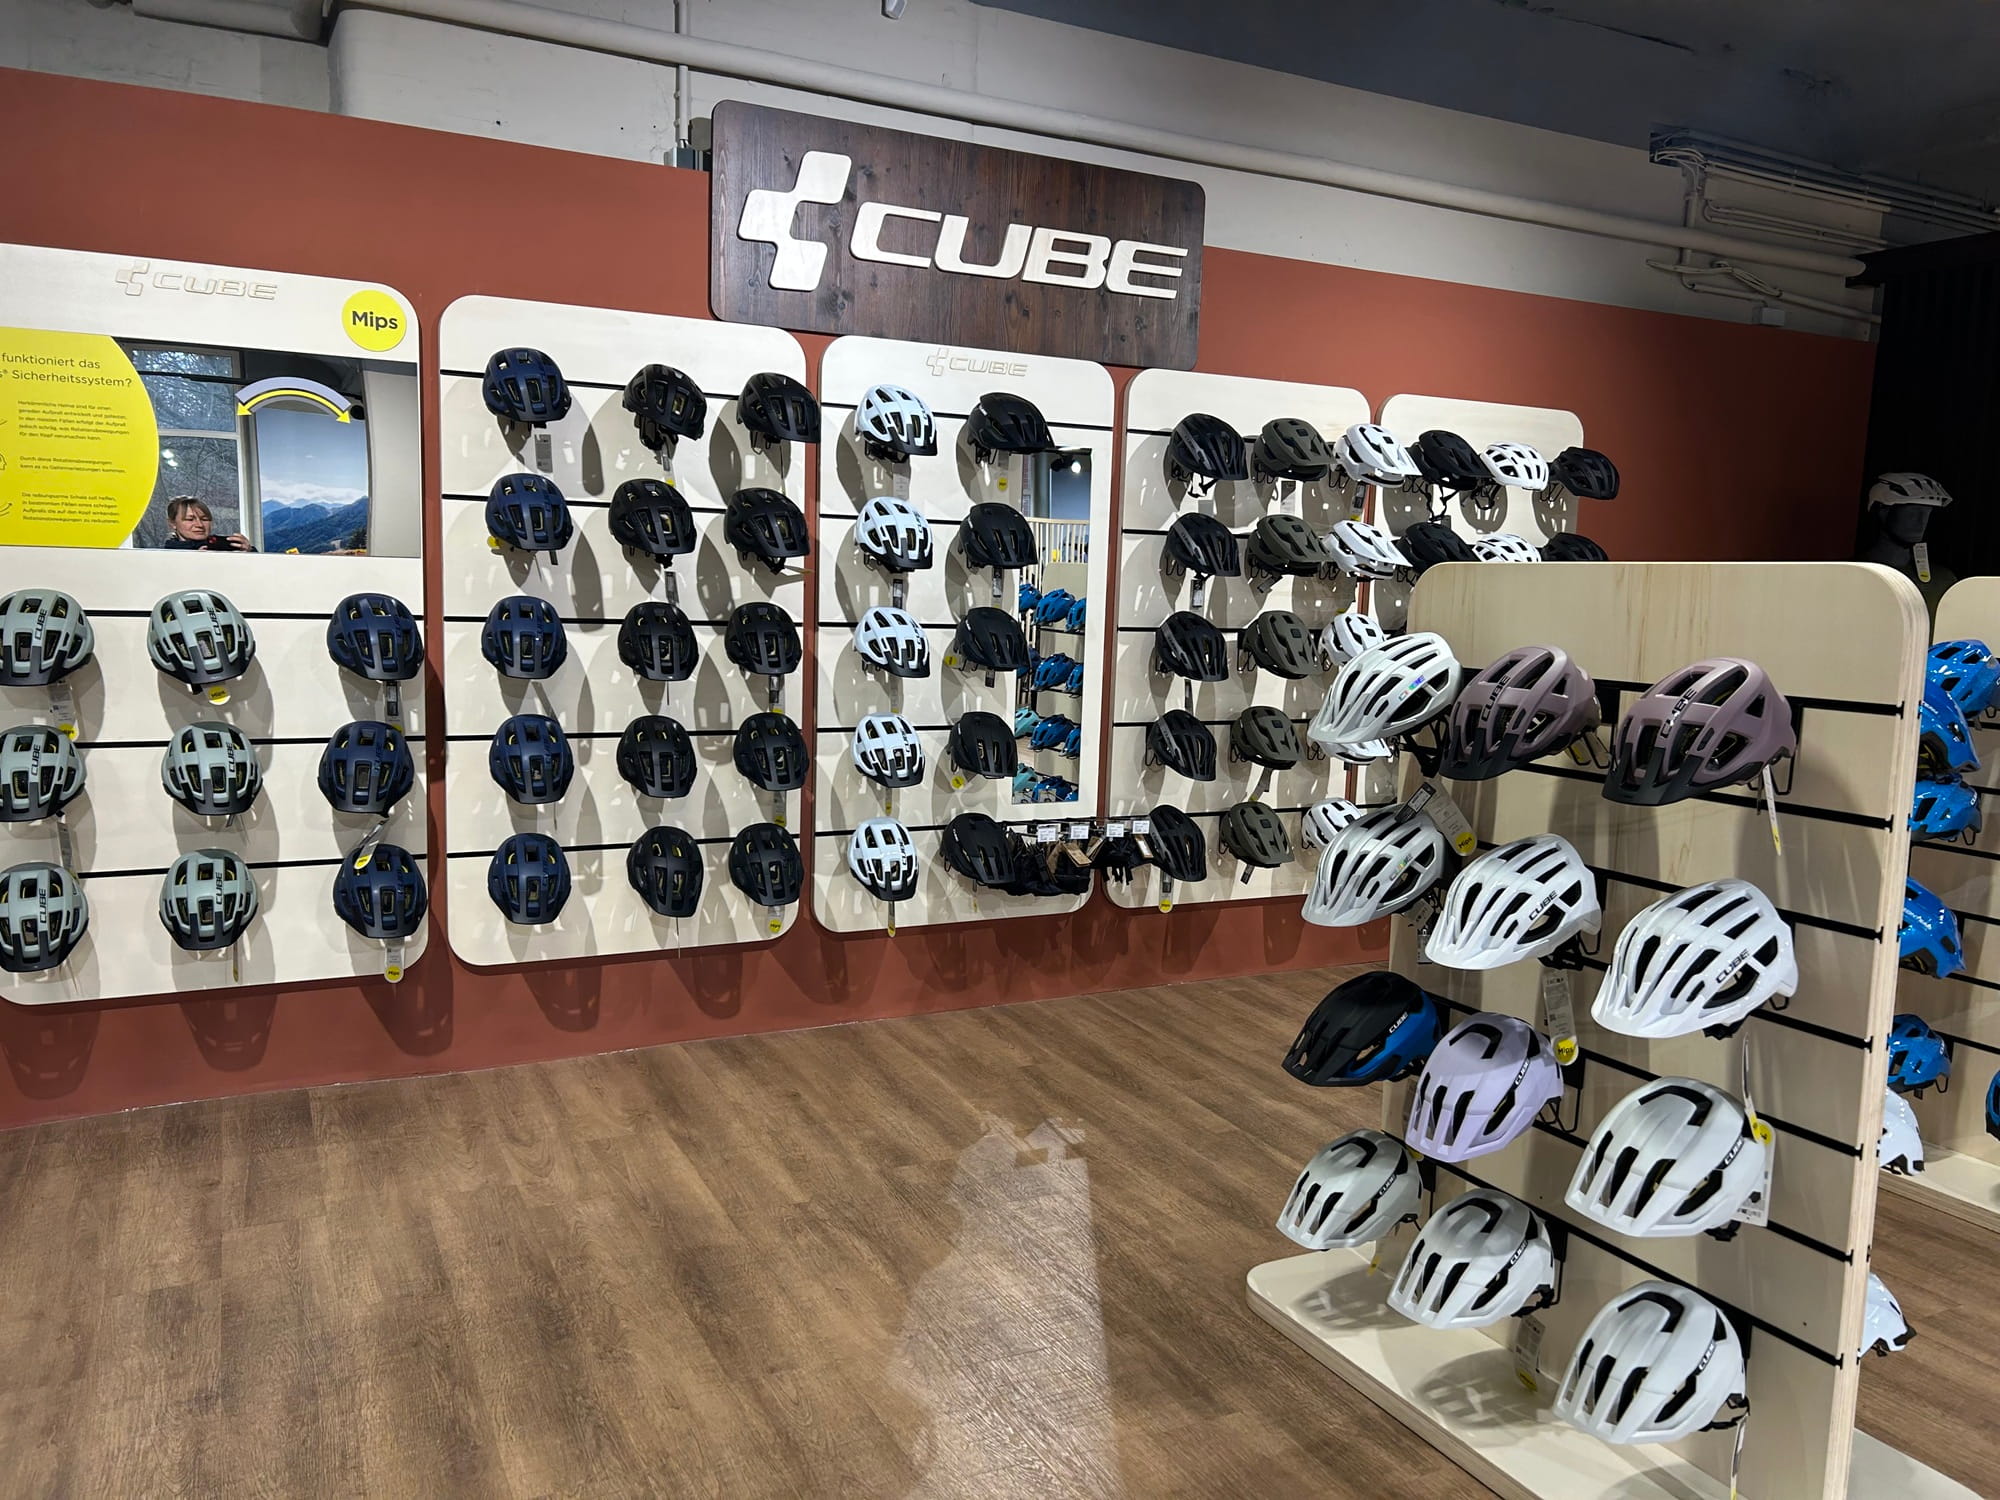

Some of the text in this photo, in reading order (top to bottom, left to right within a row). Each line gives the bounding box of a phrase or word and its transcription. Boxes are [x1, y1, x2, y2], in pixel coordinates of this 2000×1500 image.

[850, 201, 1189, 300] CUBE
[152, 271, 278, 301] CUBE
[352, 310, 399, 332] Mips
[2, 352, 101, 369] funktioniert das
[949, 357, 1029, 377] CUBE
[12, 369, 132, 387] Sicherheitssystem?
[34, 608, 48, 640] CUBE
[207, 607, 221, 636] CUBE
[1481, 675, 1511, 722] CUBE
[1660, 688, 1697, 739] CUBE
[31, 744, 41, 776] CUBE
[226, 742, 236, 773] CUBE
[1458, 836, 1473, 849] Mips
[215, 872, 223, 905] CUBE
[39, 888, 47, 924] CUBE
[1528, 890, 1559, 921] CUBE
[1716, 948, 1750, 985] CUBE
[1388, 1011, 1409, 1034] CUBE
[1557, 1047, 1574, 1055] Mips
[1515, 1058, 1529, 1086] CUBE
[1378, 1174, 1397, 1196] CUBE
[1510, 1240, 1528, 1265] CUBE
